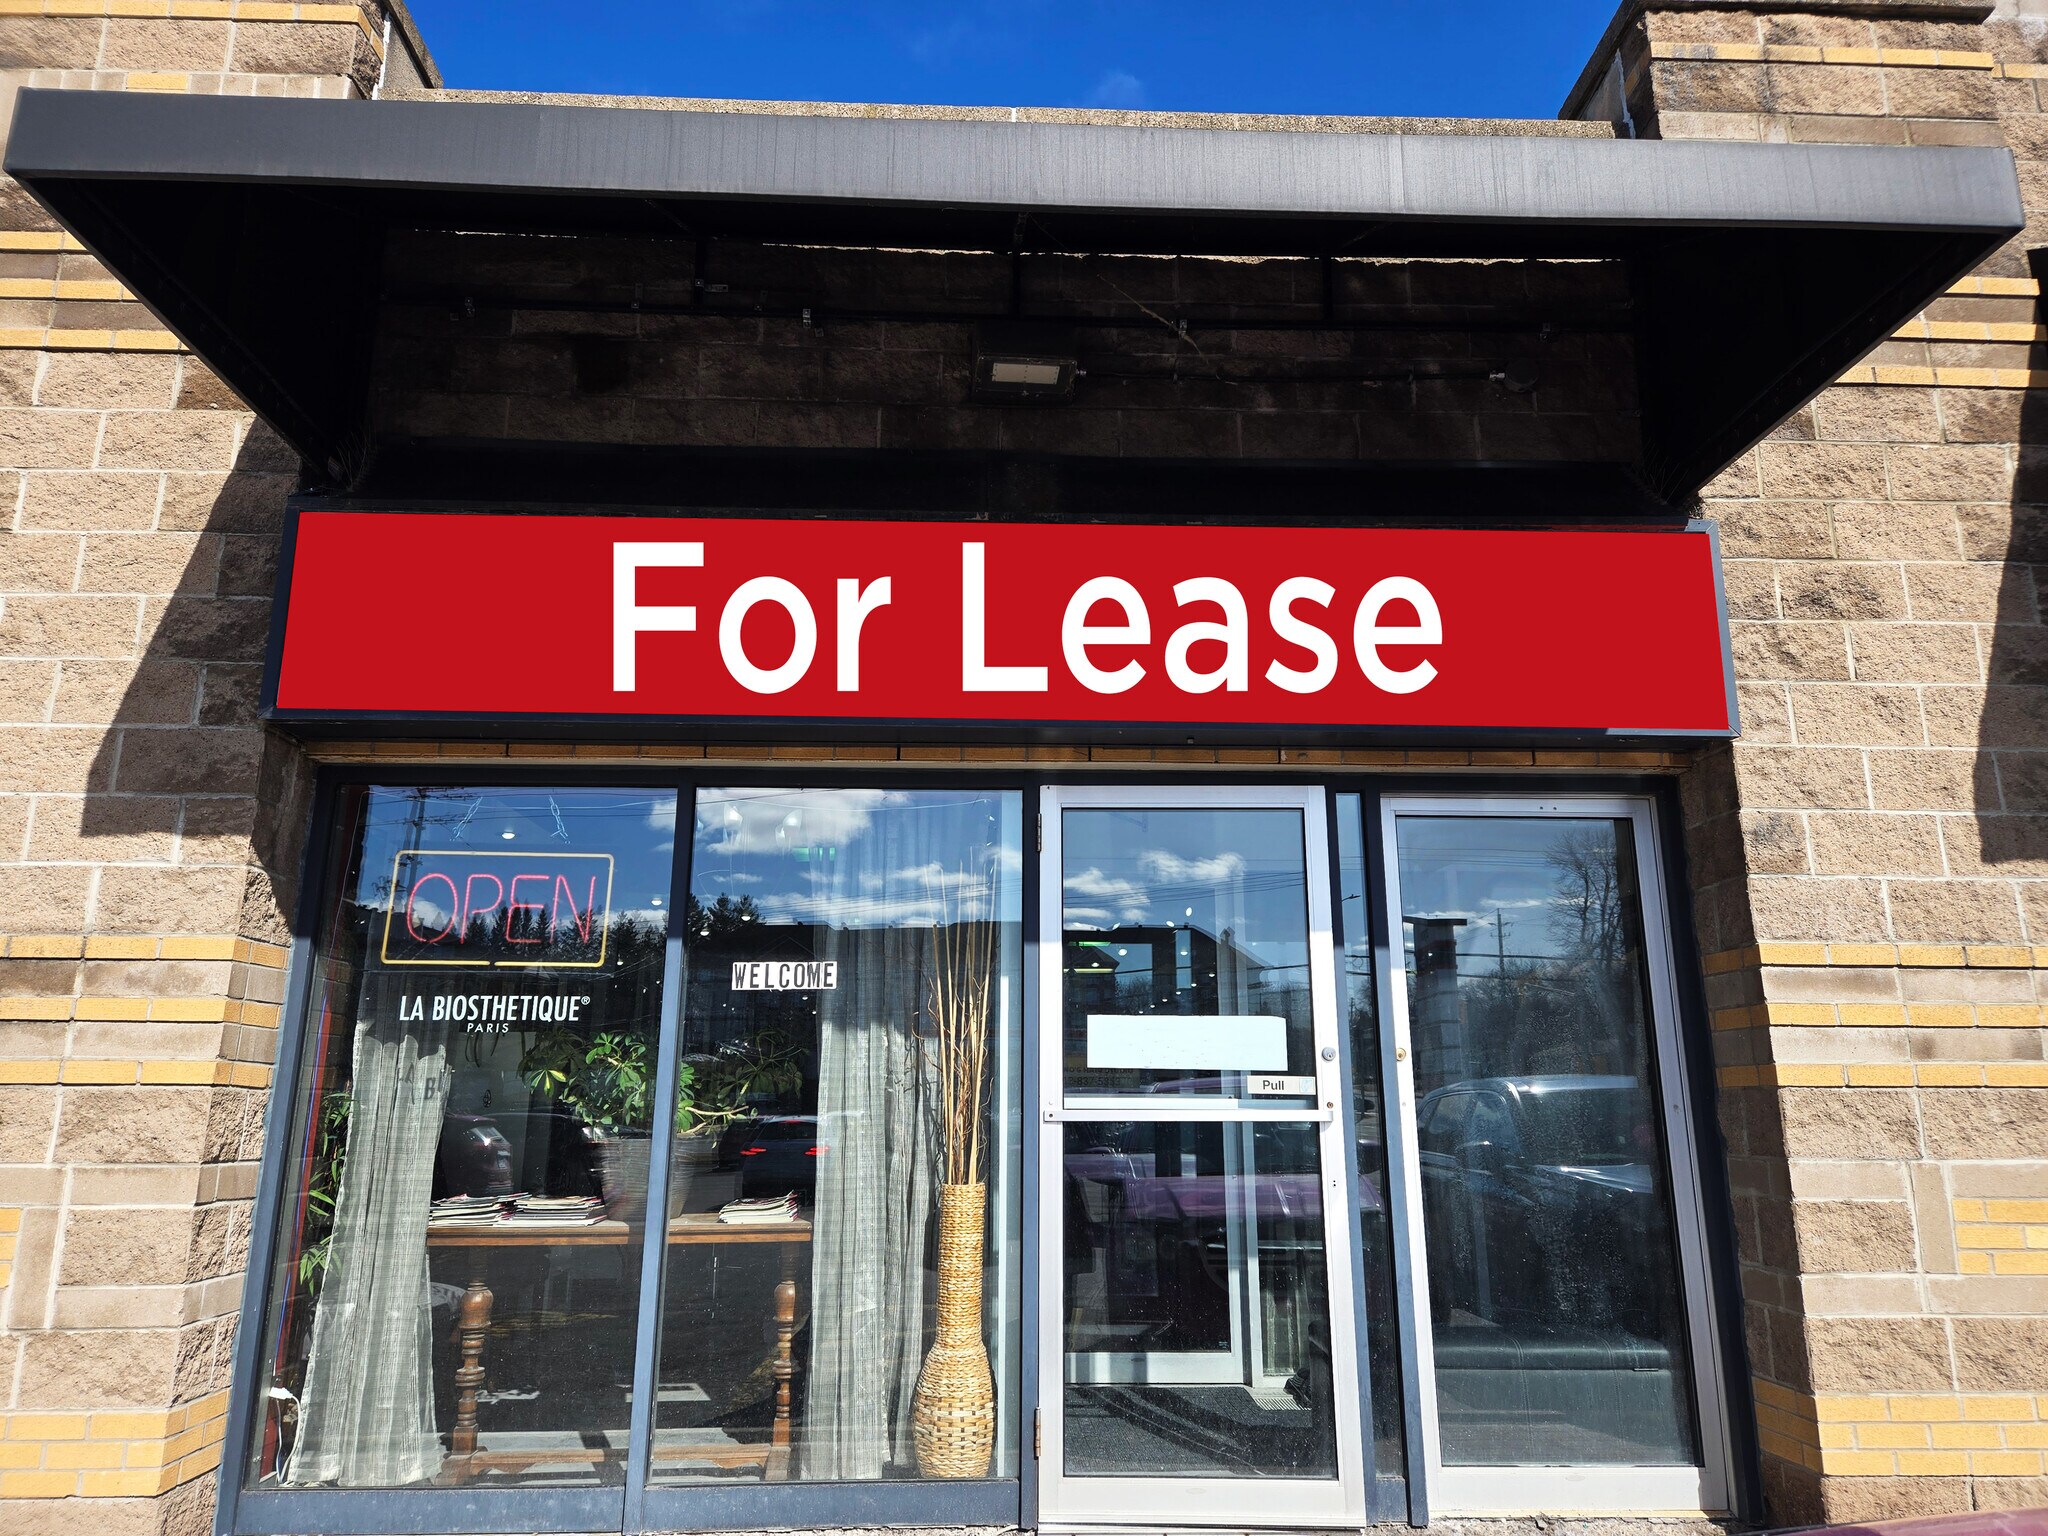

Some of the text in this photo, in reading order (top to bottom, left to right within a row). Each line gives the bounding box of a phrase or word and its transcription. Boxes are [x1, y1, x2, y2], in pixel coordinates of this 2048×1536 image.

[613, 541, 1443, 695] For Lease
[407, 873, 596, 944] OPEN
[734, 962, 834, 989] WELCOME
[399, 995, 424, 1021] LA
[466, 1022, 510, 1034] PARIS
[1262, 1079, 1286, 1091] Pull
